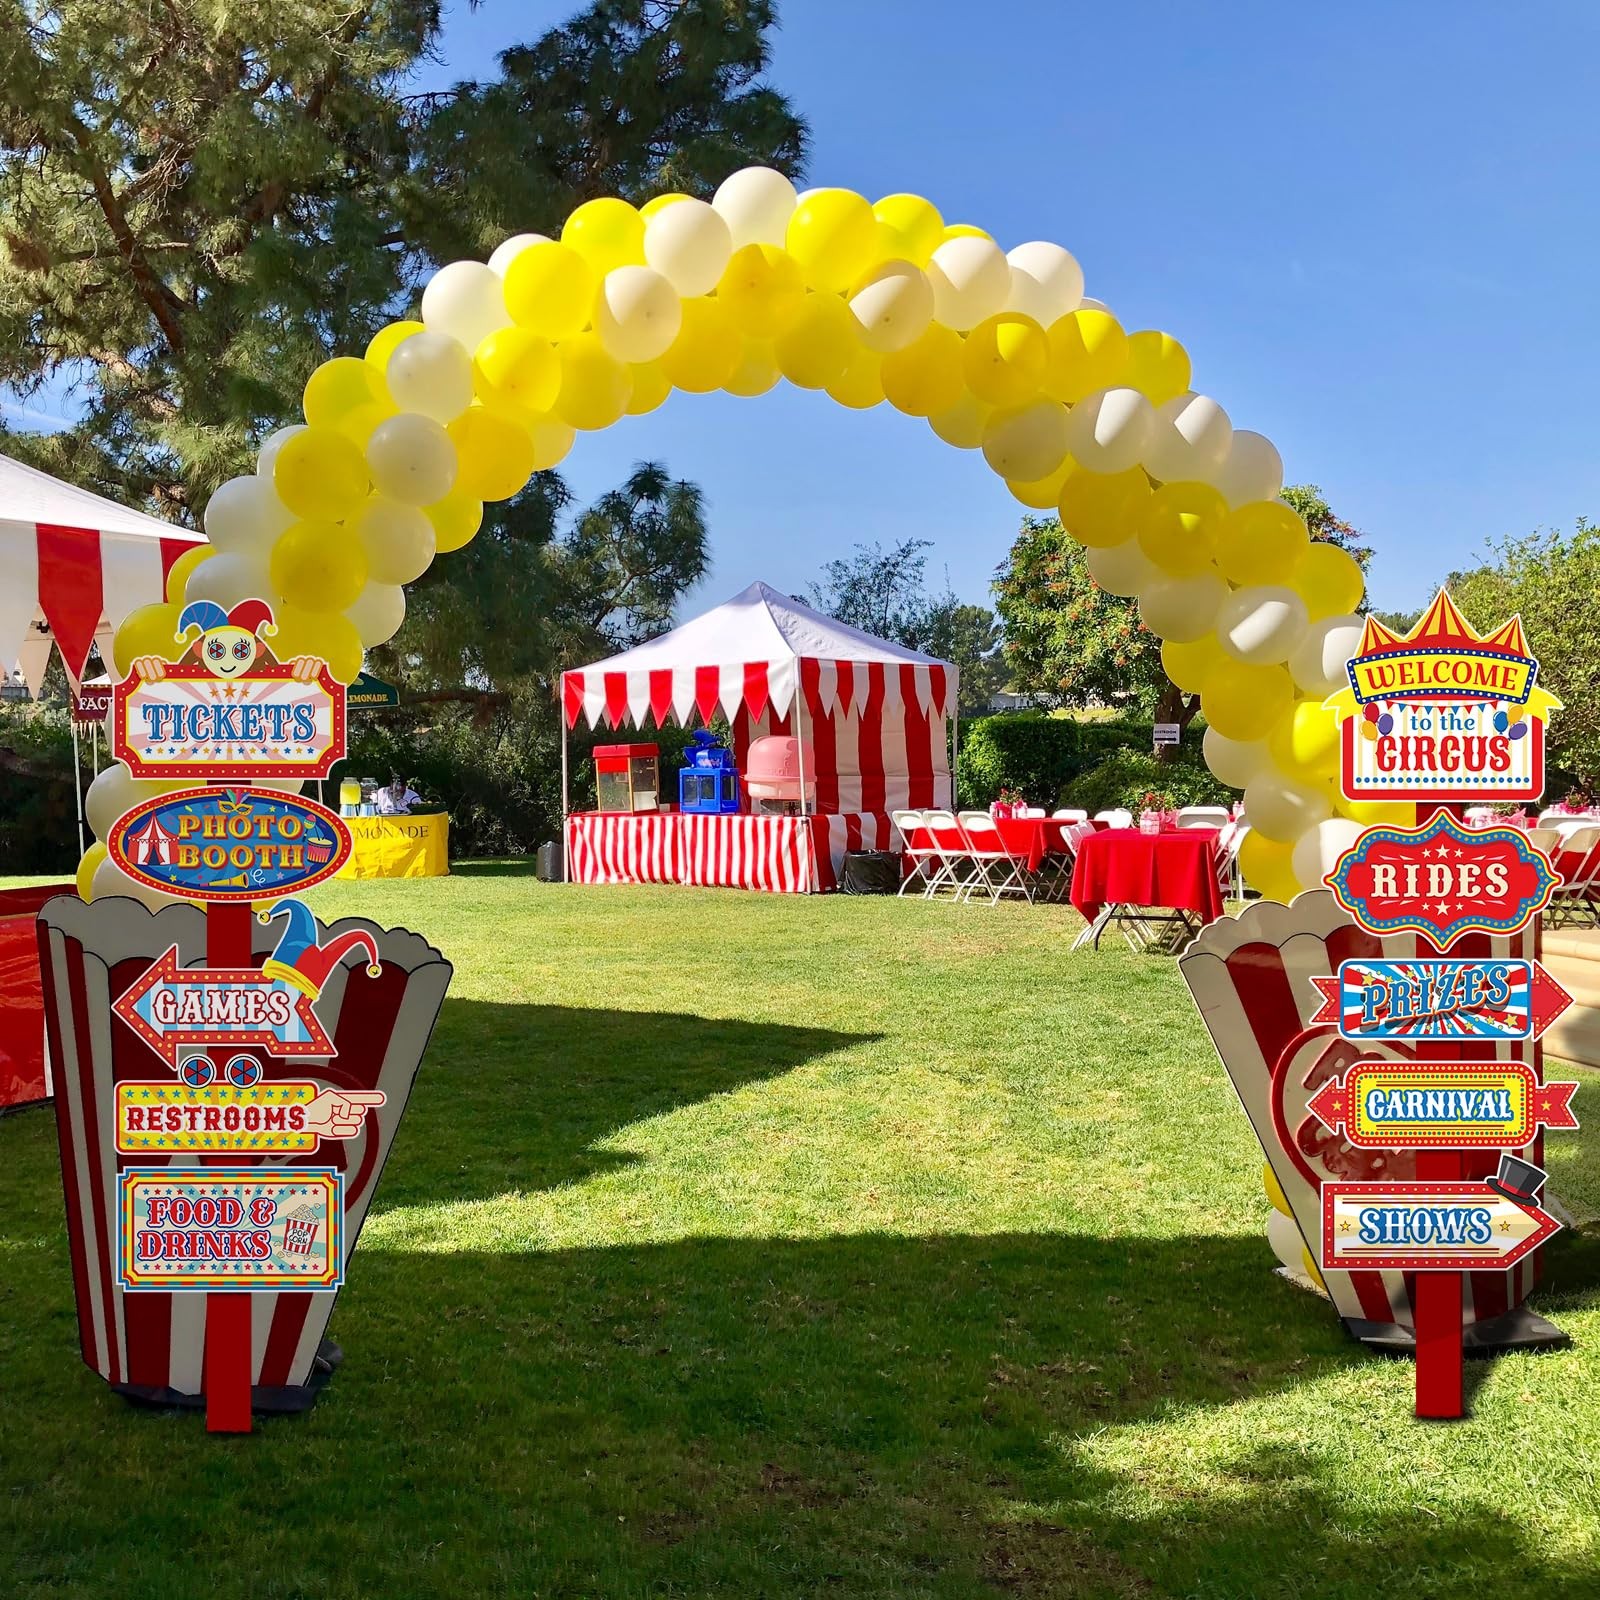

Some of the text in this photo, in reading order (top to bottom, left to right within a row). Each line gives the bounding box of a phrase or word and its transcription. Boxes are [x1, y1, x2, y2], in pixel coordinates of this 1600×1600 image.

[1364, 659, 1519, 691] WELCOME
[142, 702, 316, 743] TICKETS
[1410, 712, 1476, 732] to the
[1375, 734, 1512, 773] CIRCUS
[178, 813, 305, 840] PHOTO
[354, 825, 430, 840] MONADE
[177, 844, 305, 871] BOOTH
[1370, 862, 1511, 899] RIDES
[152, 987, 291, 1026] GAMES
[1362, 965, 1512, 1025] PRIZES
[126, 1105, 306, 1133] RESTROOMS
[1365, 1088, 1515, 1123] CARNIVAL
[146, 1196, 277, 1229] FOOD &
[1359, 1207, 1492, 1245] SHOWS
[138, 1229, 273, 1261] DRINKS
[288, 1235, 309, 1244] CORN
[292, 1229, 309, 1238] POP
